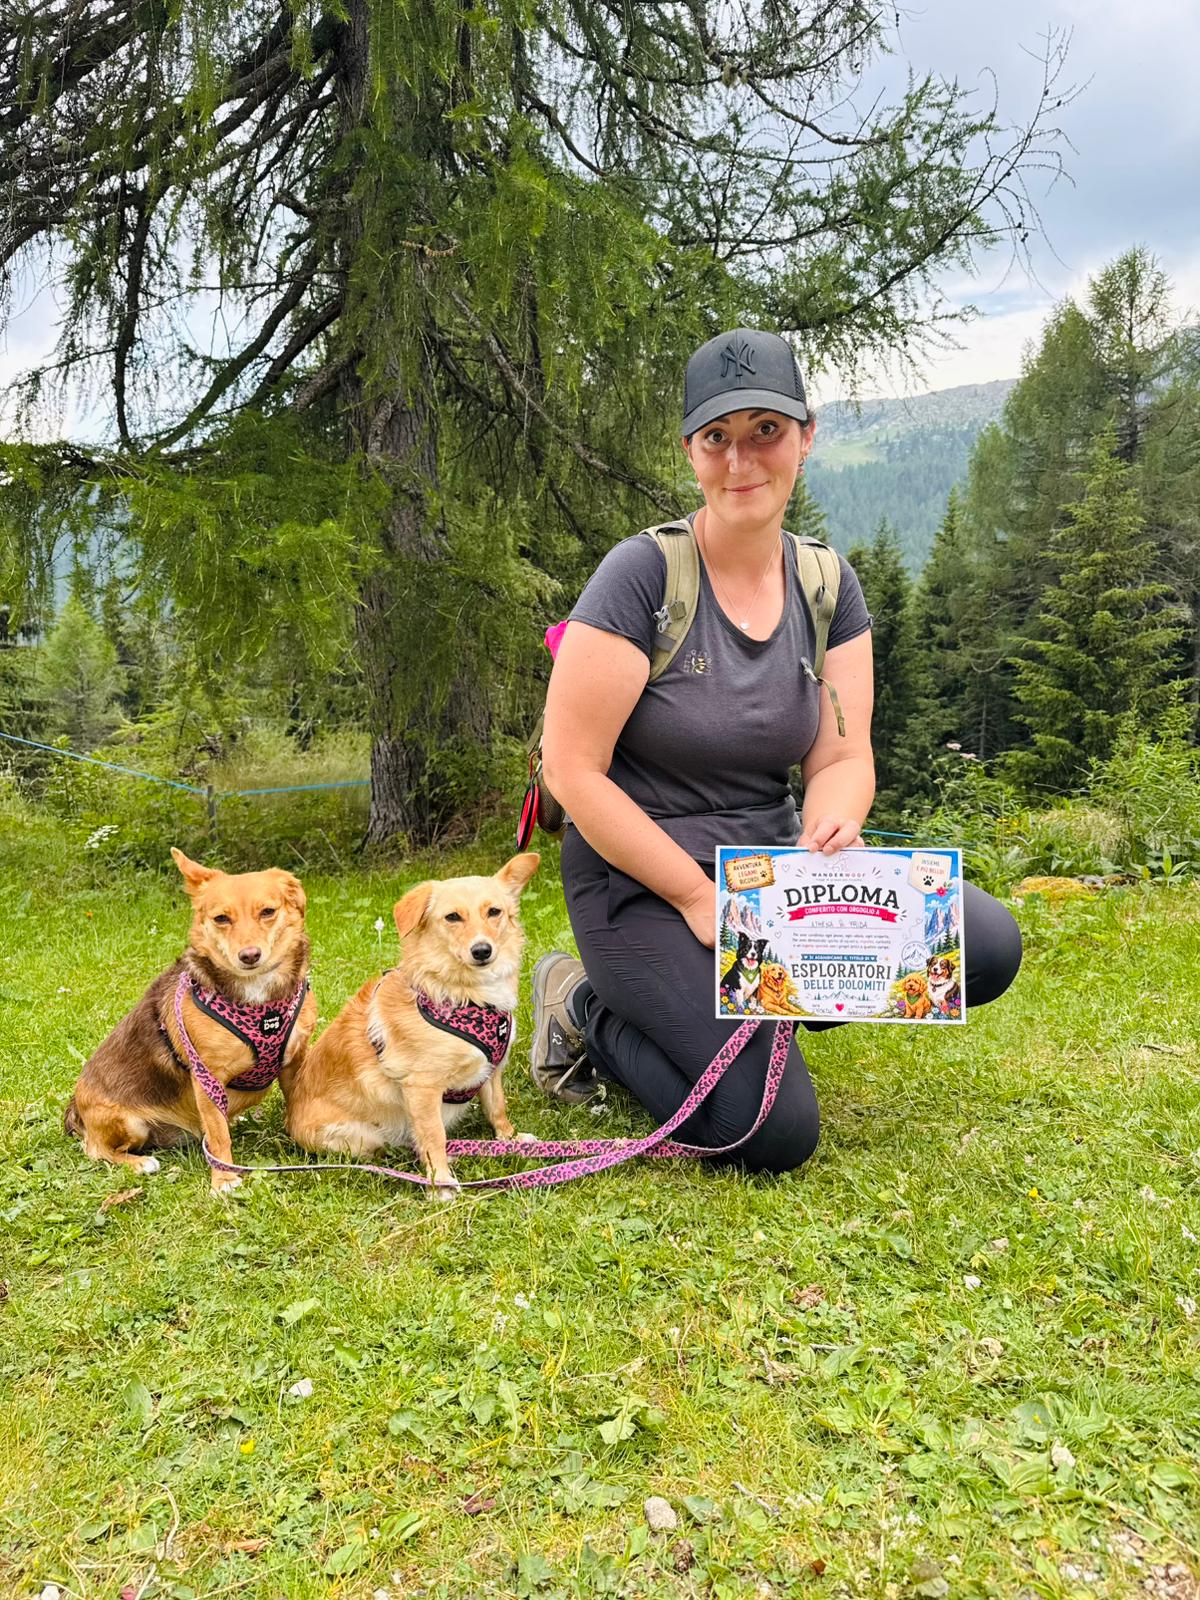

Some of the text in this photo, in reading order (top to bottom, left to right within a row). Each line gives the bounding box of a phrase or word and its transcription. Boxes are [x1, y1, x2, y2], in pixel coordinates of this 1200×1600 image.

[720, 340, 756, 378] NY
[783, 884, 900, 909] DIPLOMA
[804, 905, 836, 915] CONFERITO
[836, 905, 848, 913] CON
[848, 905, 875, 915] ORGOGLIO
[791, 963, 892, 980] ESPLORATORI
[803, 979, 886, 991] DELLE DOLOMITI
[263, 1021, 280, 1030] Dog
